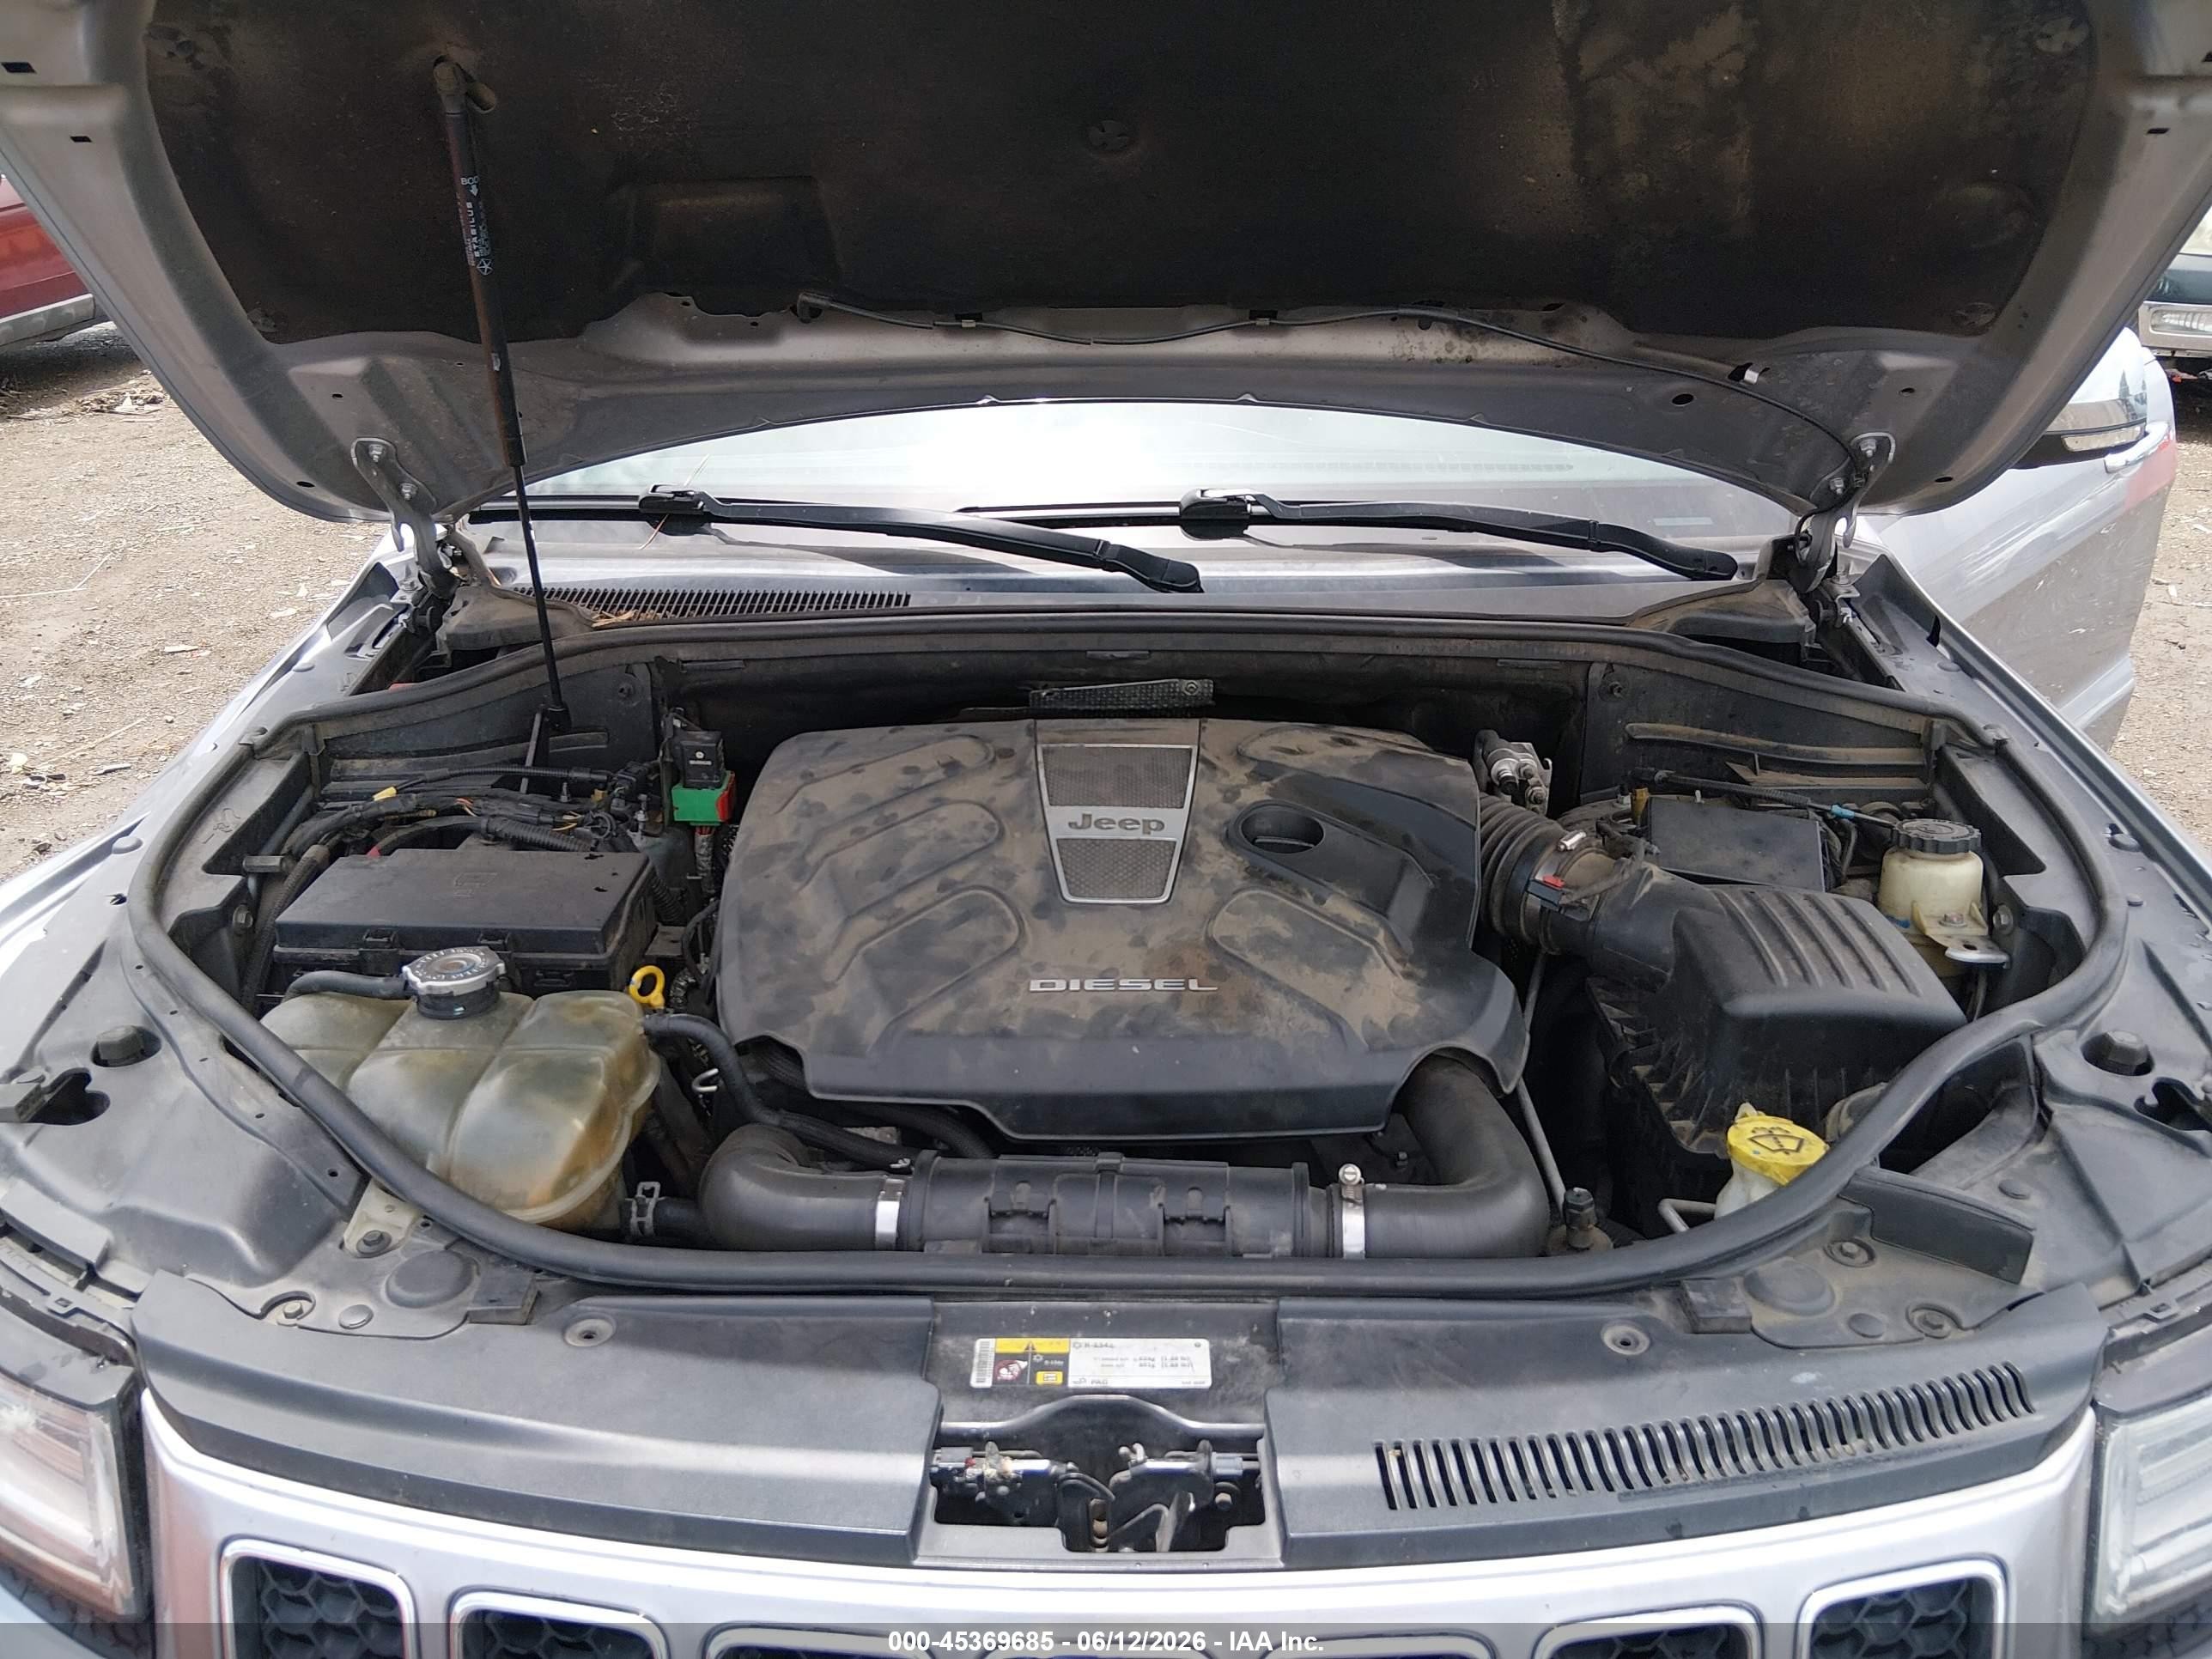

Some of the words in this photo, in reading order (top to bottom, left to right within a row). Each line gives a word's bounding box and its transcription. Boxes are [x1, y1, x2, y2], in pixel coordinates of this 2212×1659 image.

[465, 202, 481, 258] STABILUS
[1067, 812, 1165, 836] Jeep
[1029, 978, 1218, 992] DIESEL
